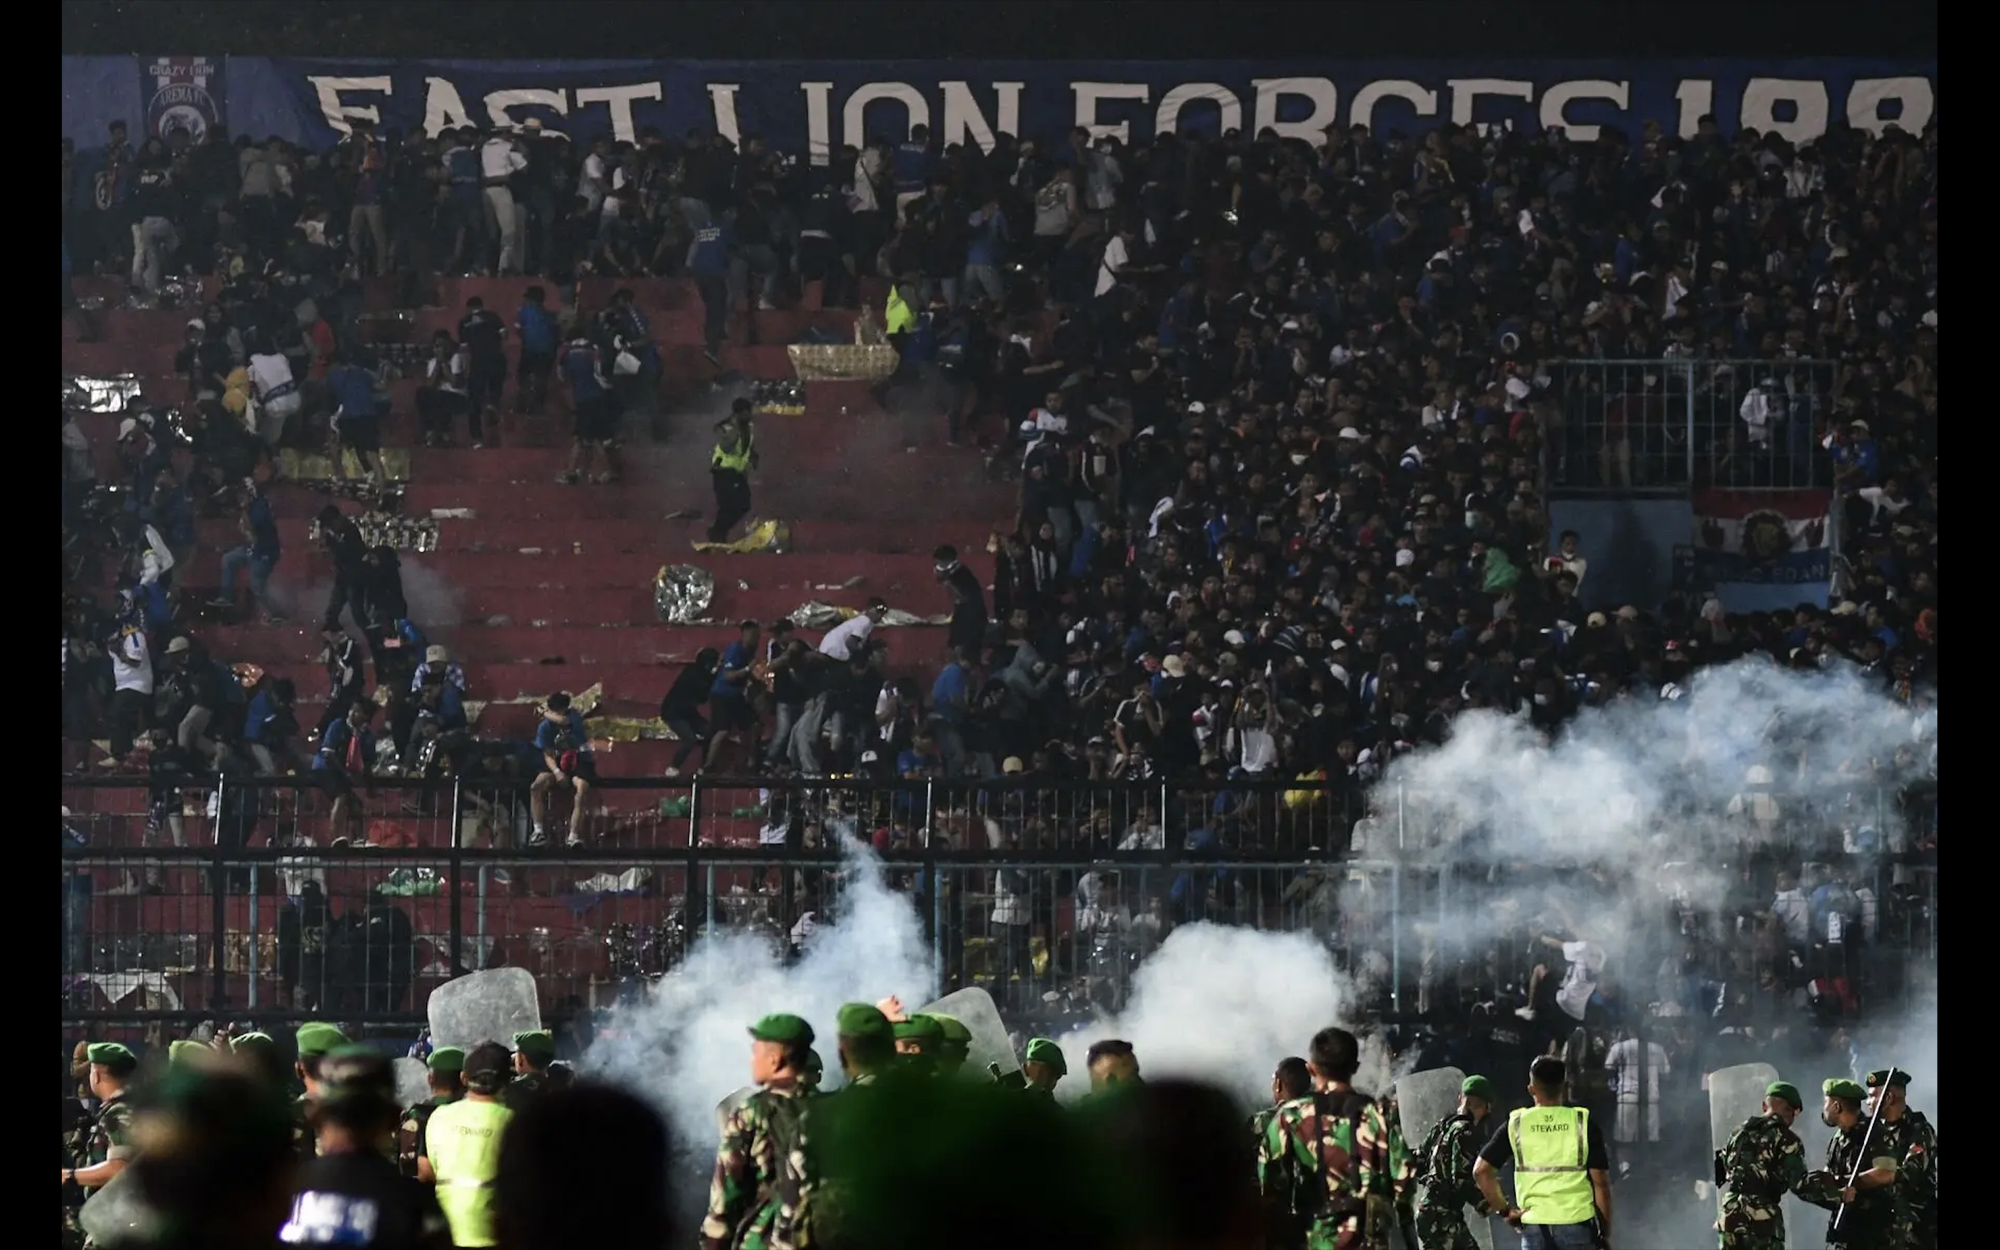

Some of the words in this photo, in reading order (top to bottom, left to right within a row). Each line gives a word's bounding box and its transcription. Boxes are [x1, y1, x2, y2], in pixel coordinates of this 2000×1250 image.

[149, 65, 186, 76] CRAZY
[307, 76, 661, 150] EAST
[1069, 77, 1629, 149] FORCES
[1530, 1123, 1569, 1132] STEWARD
